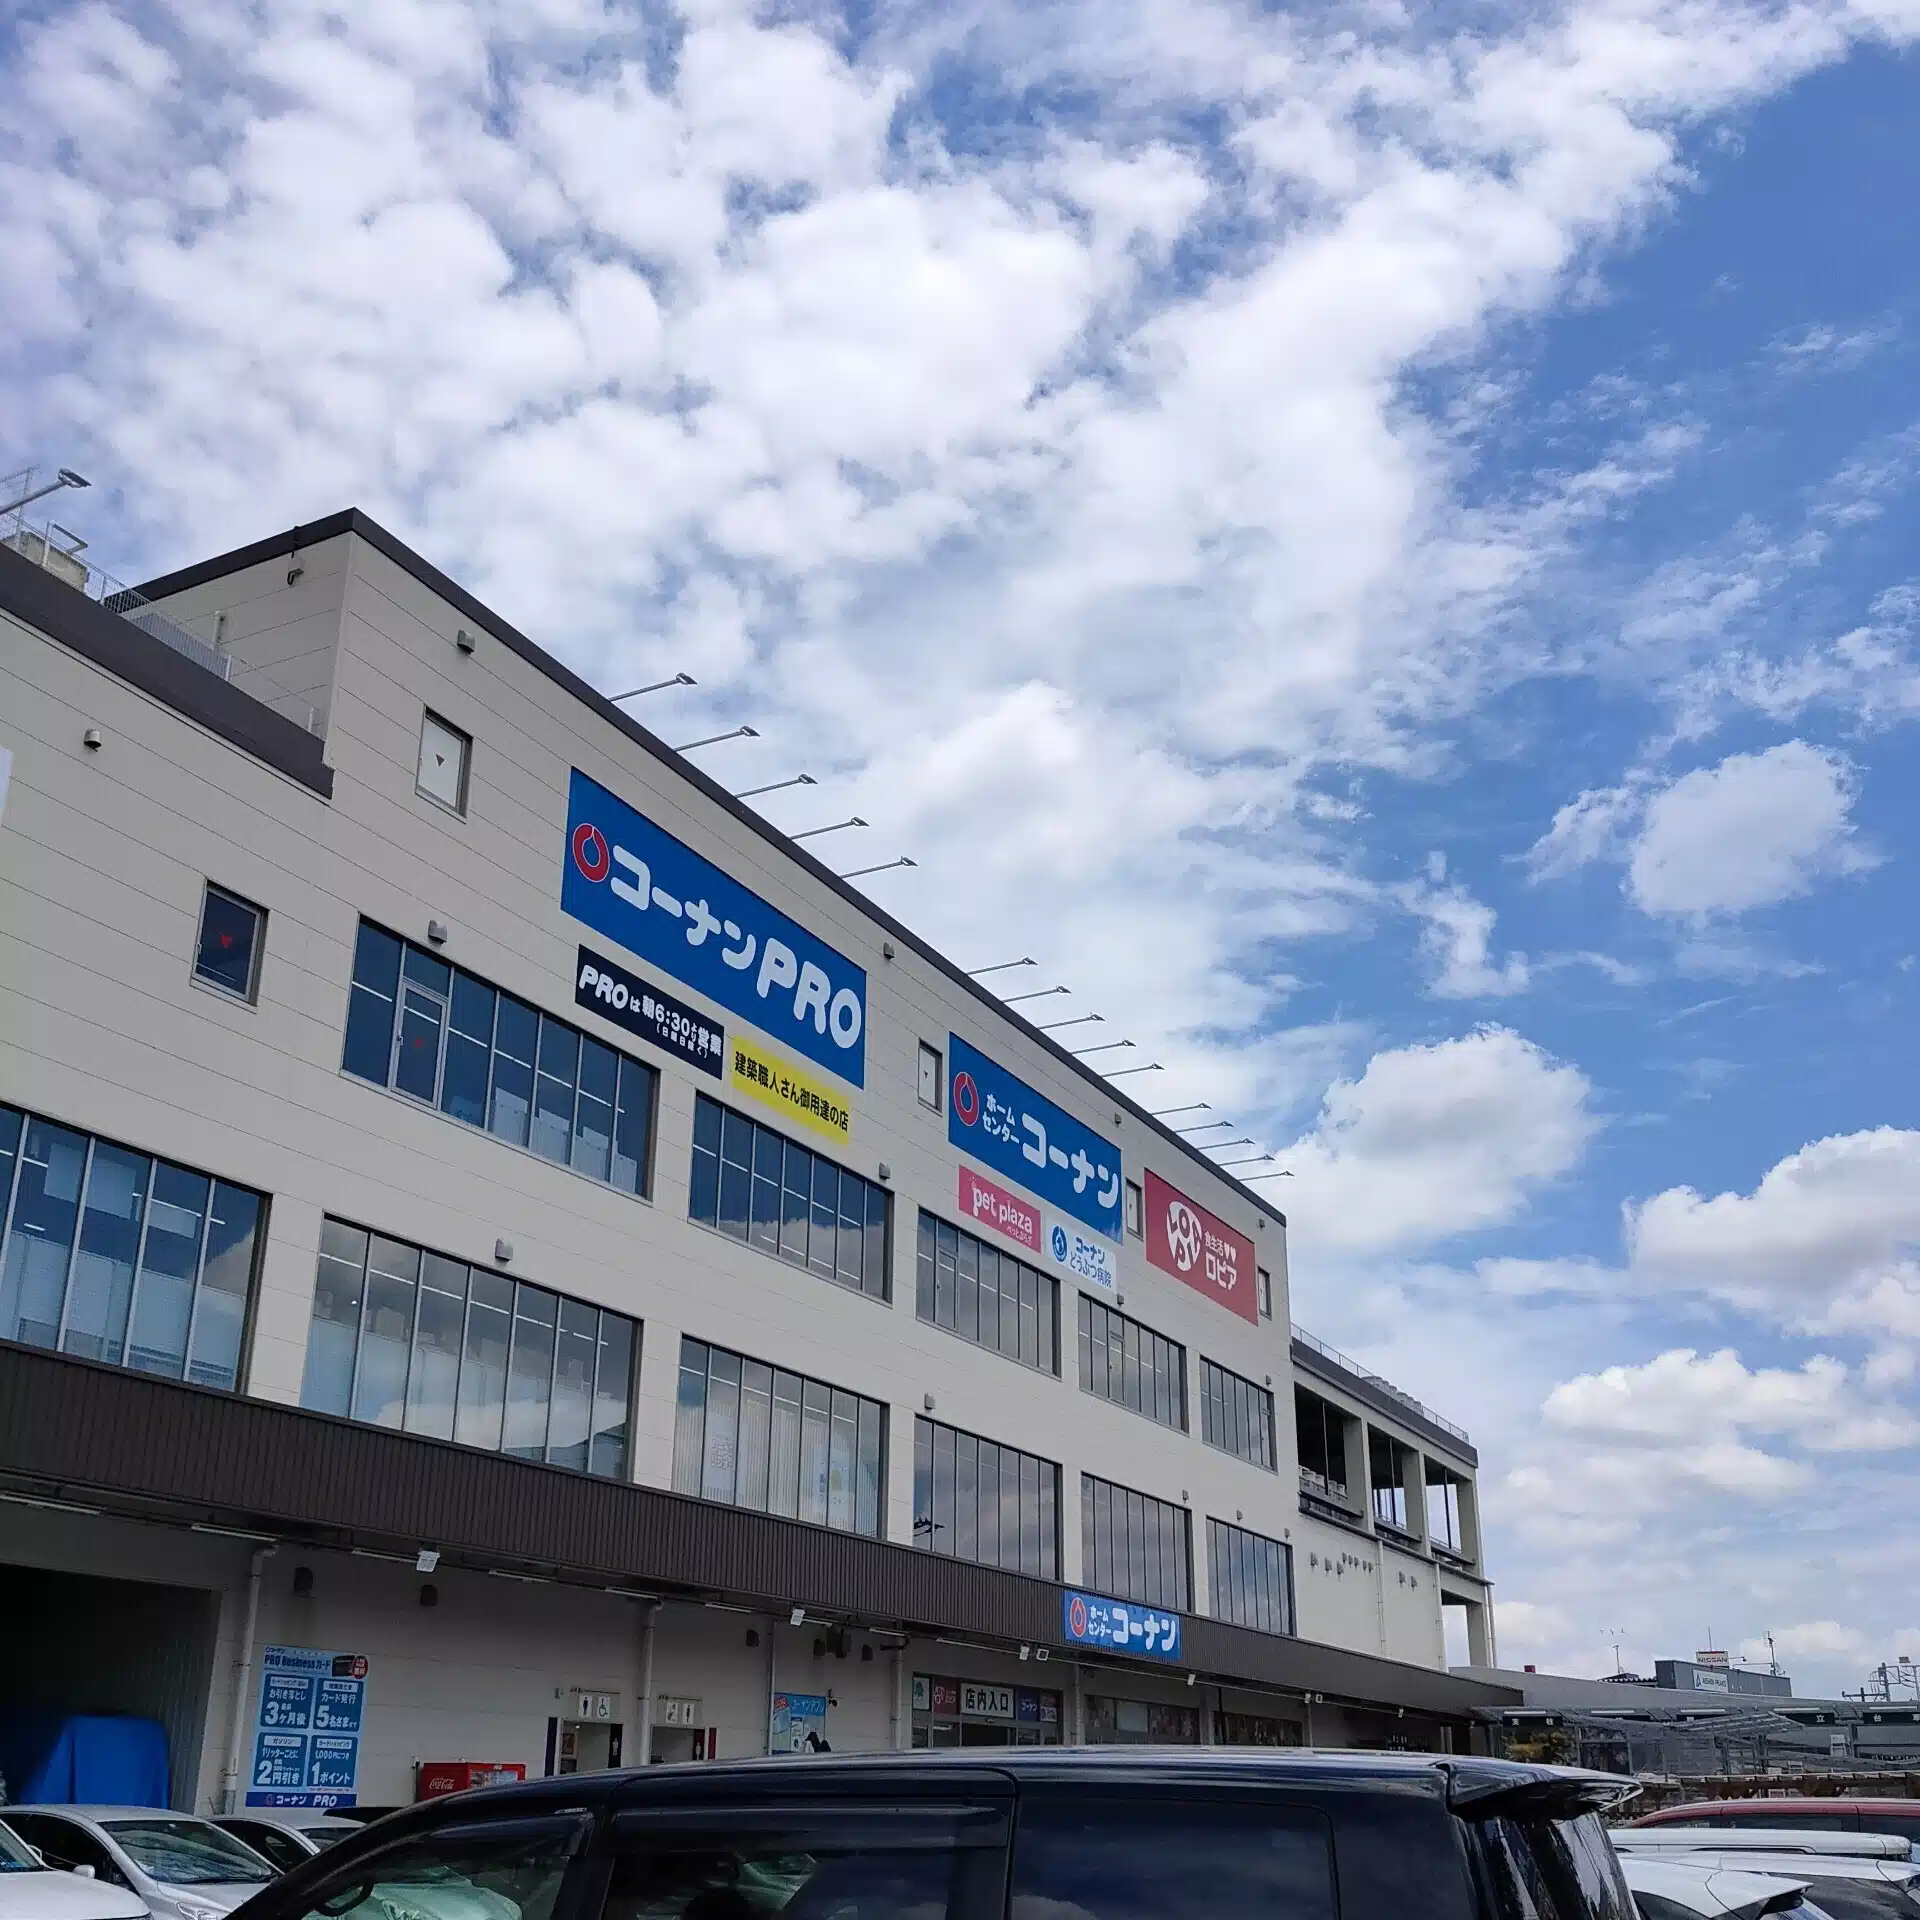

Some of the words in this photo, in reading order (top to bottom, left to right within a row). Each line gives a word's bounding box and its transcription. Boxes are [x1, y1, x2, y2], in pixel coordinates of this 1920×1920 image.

[735, 1051, 848, 1132] 建築職人さん御用達の店
[986, 1093, 1016, 1126] ホーム
[982, 1111, 1020, 1144] センター
[1022, 1112, 1119, 1209] コーナン
[972, 1182, 997, 1217] pet
[999, 1200, 1032, 1234] plaza
[1076, 1237, 1105, 1264] コーナン
[1070, 1251, 1112, 1288] どうぶつ病院
[1205, 1252, 1237, 1290] ロピア
[1088, 1621, 1111, 1637] センター
[1090, 1605, 1109, 1622] ホーム
[1112, 1607, 1176, 1651] コーナン
[321, 1693, 356, 1704] カード発行
[965, 1687, 1008, 1711] 店内入口
[276, 1795, 307, 1805] コーナン
[313, 1795, 337, 1807] PRO
